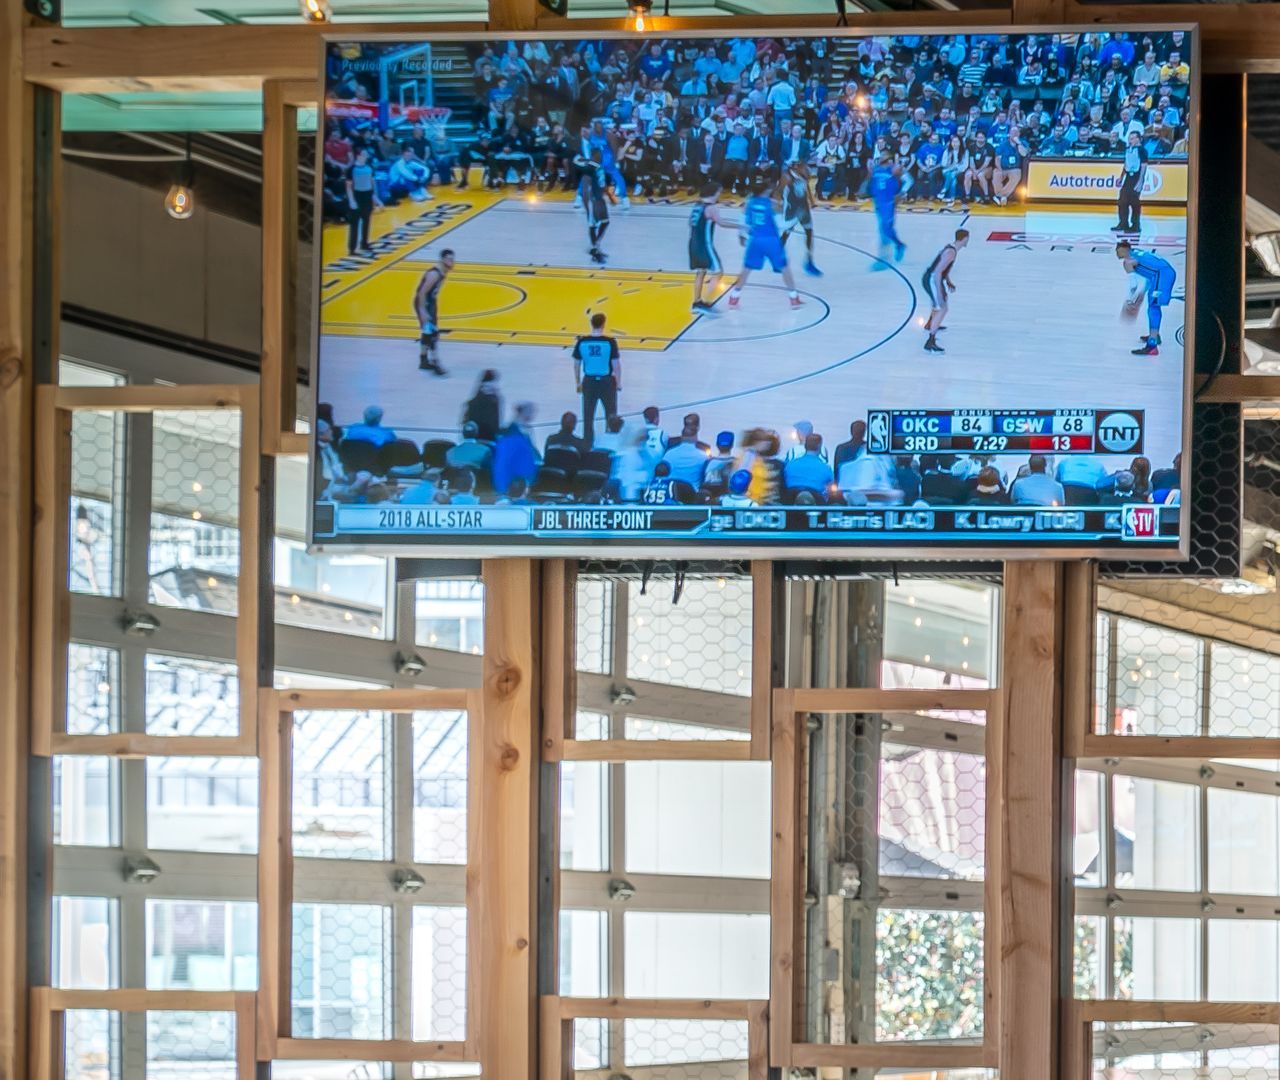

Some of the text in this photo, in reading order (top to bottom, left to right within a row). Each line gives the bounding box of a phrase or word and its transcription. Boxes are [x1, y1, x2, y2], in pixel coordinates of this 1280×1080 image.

[902, 418, 1083, 433] OKC 84 GSW 68
[1100, 426, 1137, 442] TNT
[904, 437, 1071, 450] 3RD 7:29 13
[379, 510, 483, 528] 2018 ALL-STAR
[538, 510, 654, 530] JBL THREE-POINT
[977, 512, 1033, 532] Lowry
[1138, 510, 1152, 532] TV
